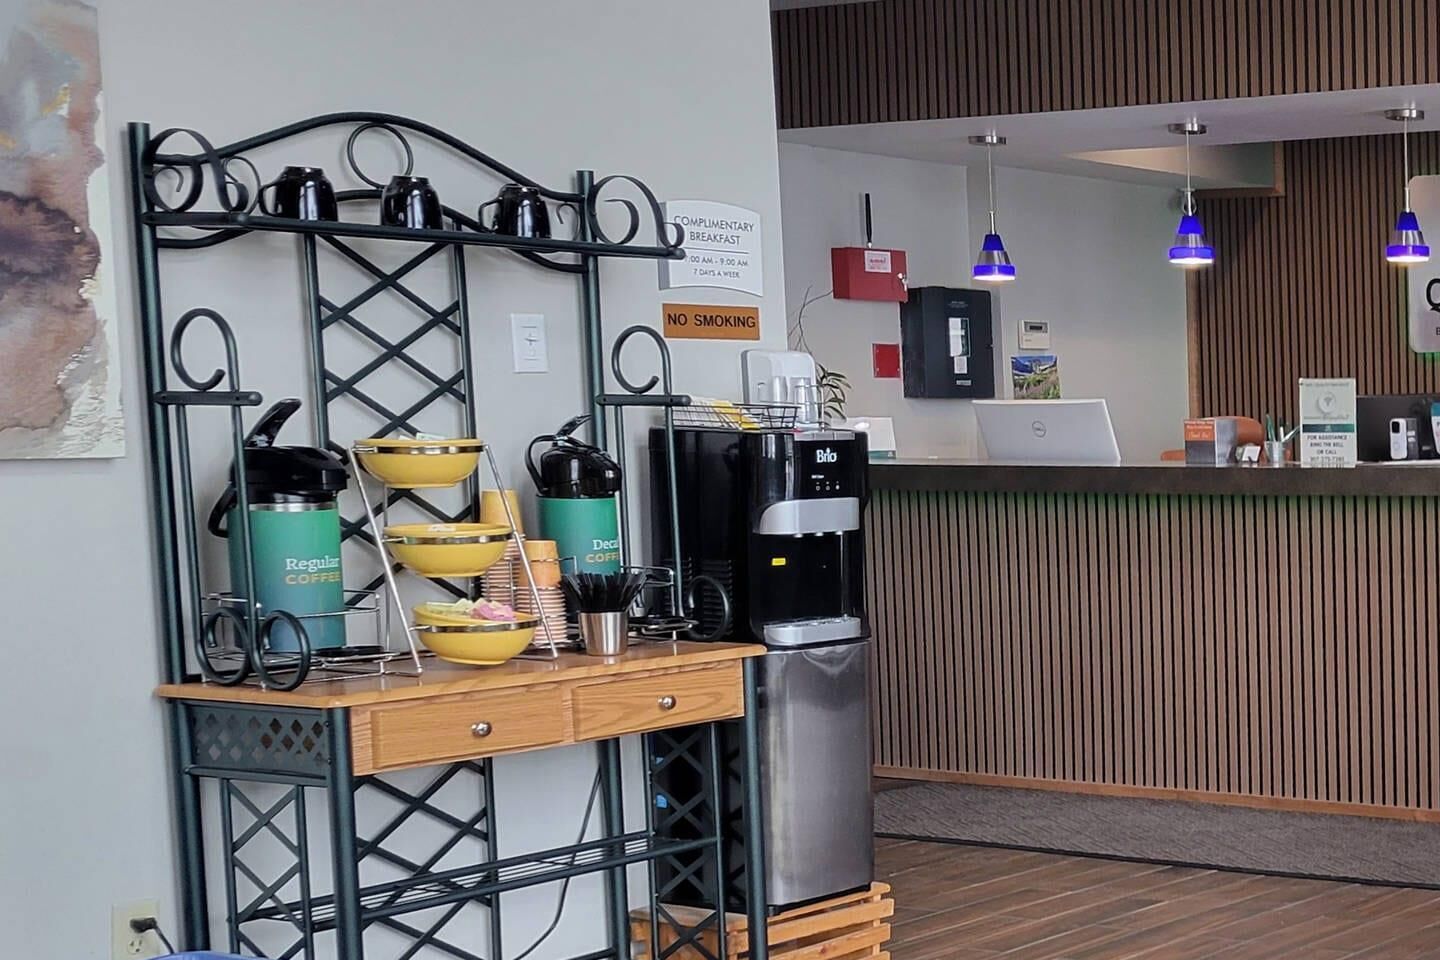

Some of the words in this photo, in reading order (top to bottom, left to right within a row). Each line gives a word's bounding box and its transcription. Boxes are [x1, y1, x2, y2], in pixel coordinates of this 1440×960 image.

[673, 215, 754, 233] COMPLIMENTARY
[689, 231, 741, 245] BREAKFAST
[667, 312, 688, 326] NO
[694, 313, 756, 328] SMOKING
[816, 447, 838, 464] Brio
